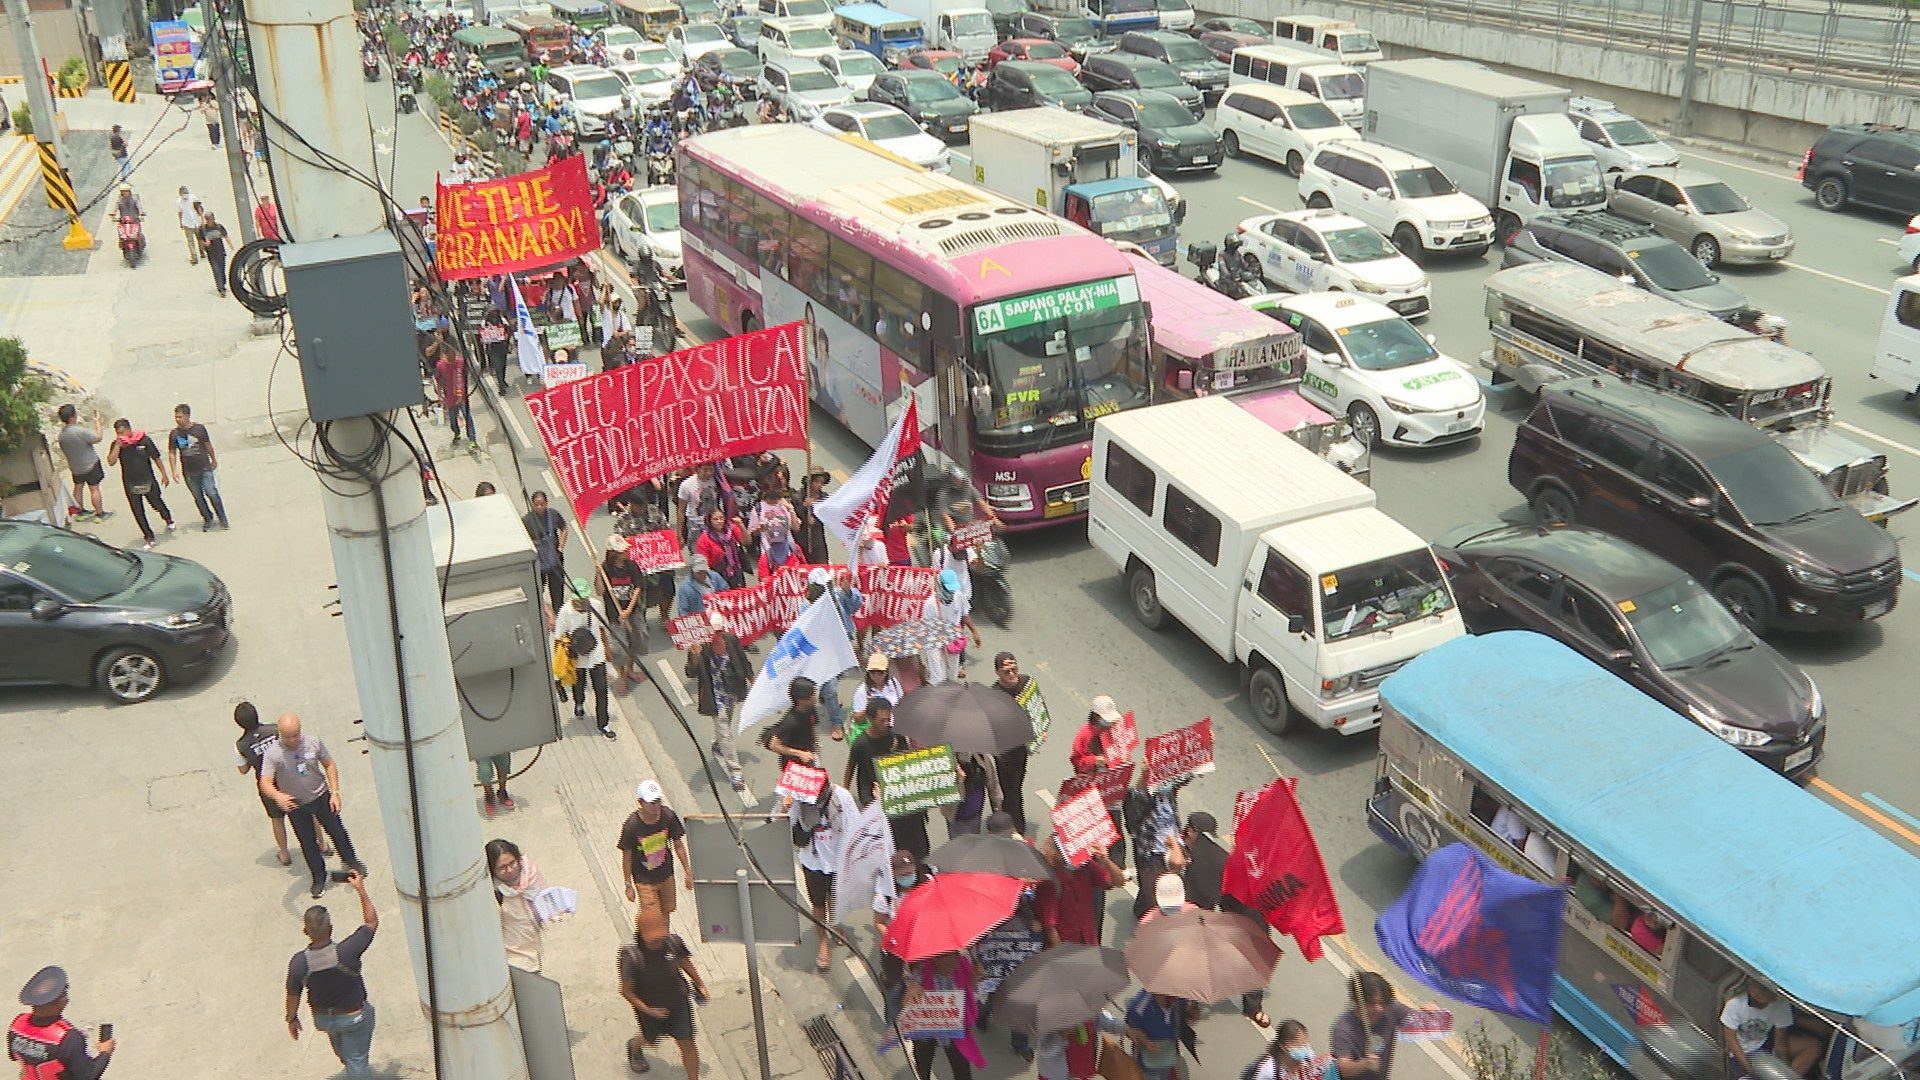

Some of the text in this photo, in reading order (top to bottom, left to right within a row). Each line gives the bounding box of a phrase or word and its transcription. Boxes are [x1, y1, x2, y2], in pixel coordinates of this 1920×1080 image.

[476, 175, 560, 226] THE
[442, 206, 588, 270] GRANARY!
[979, 307, 1002, 332] 6A
[1005, 296, 1056, 318] SAPANG
[525, 367, 635, 447] REJECT
[638, 350, 700, 416] PAX
[1006, 389, 1041, 407] FVR
[995, 471, 1017, 482] MSJ
[1150, 740, 1181, 766] HARI
[1183, 733, 1203, 755] NG
[882, 755, 952, 783] US-MARCOS
[883, 771, 957, 802] PANAGUTIN!
